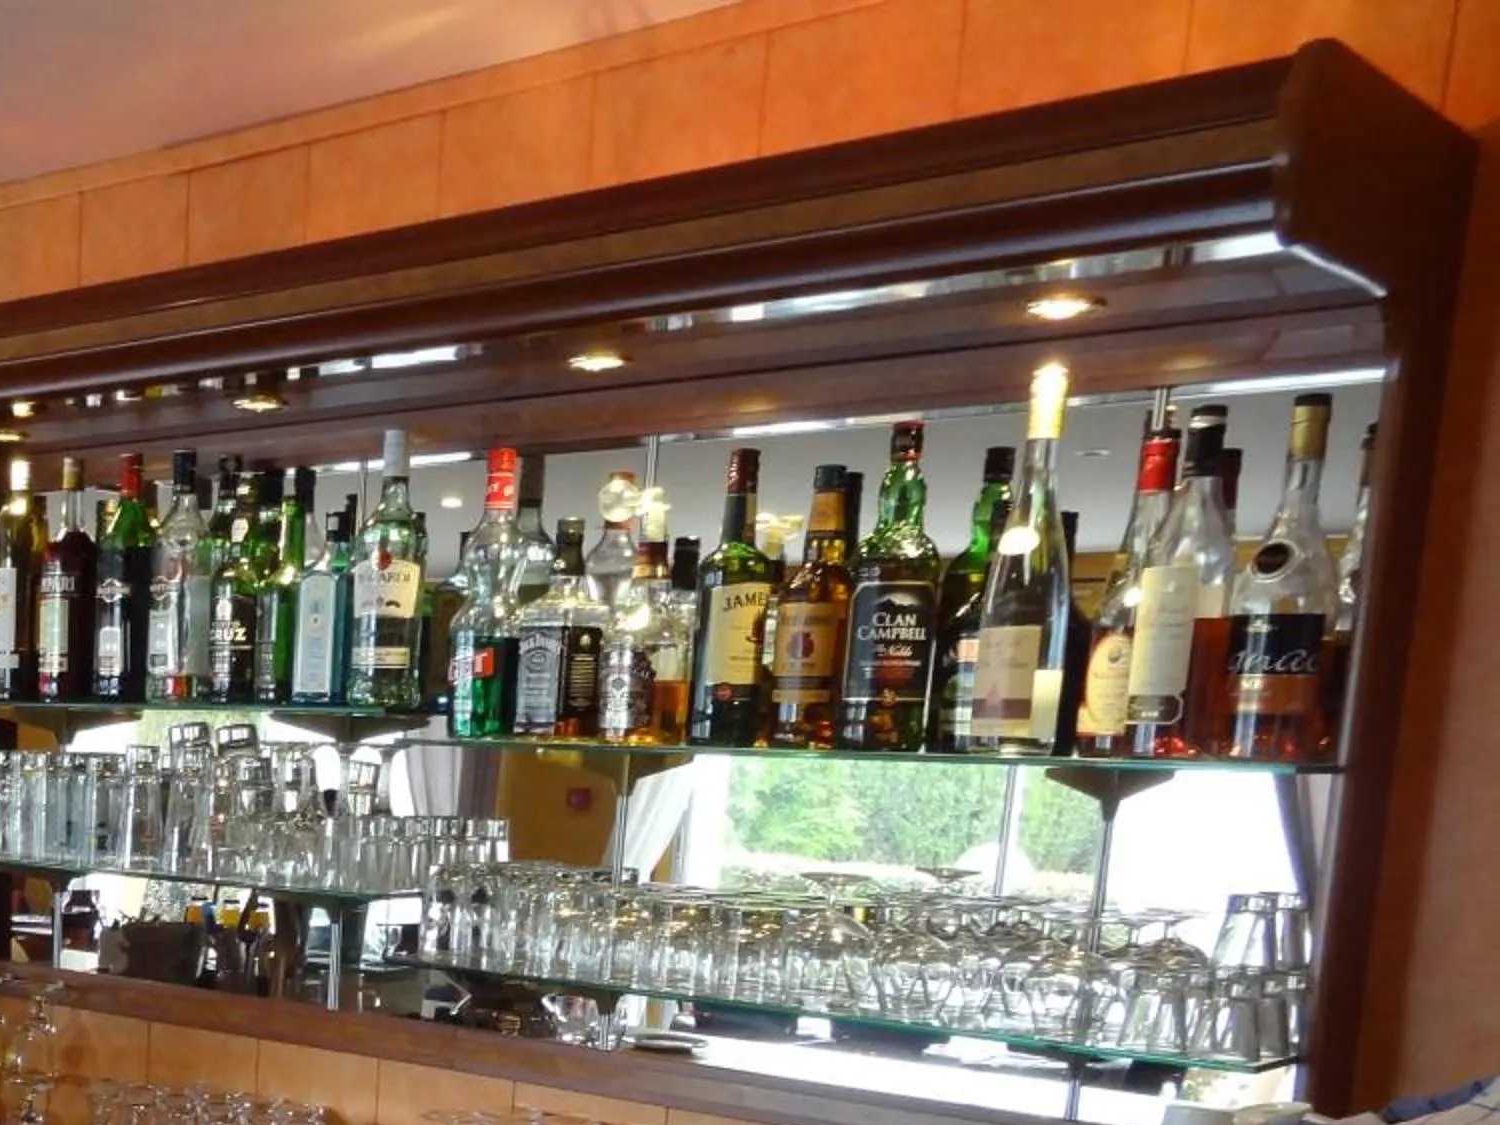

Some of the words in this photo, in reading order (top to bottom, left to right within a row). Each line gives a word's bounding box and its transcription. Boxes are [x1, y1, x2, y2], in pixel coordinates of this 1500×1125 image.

[872, 611, 917, 627] CLAN
[210, 626, 247, 641] CRUZ
[856, 625, 927, 641] CAMPBELL
